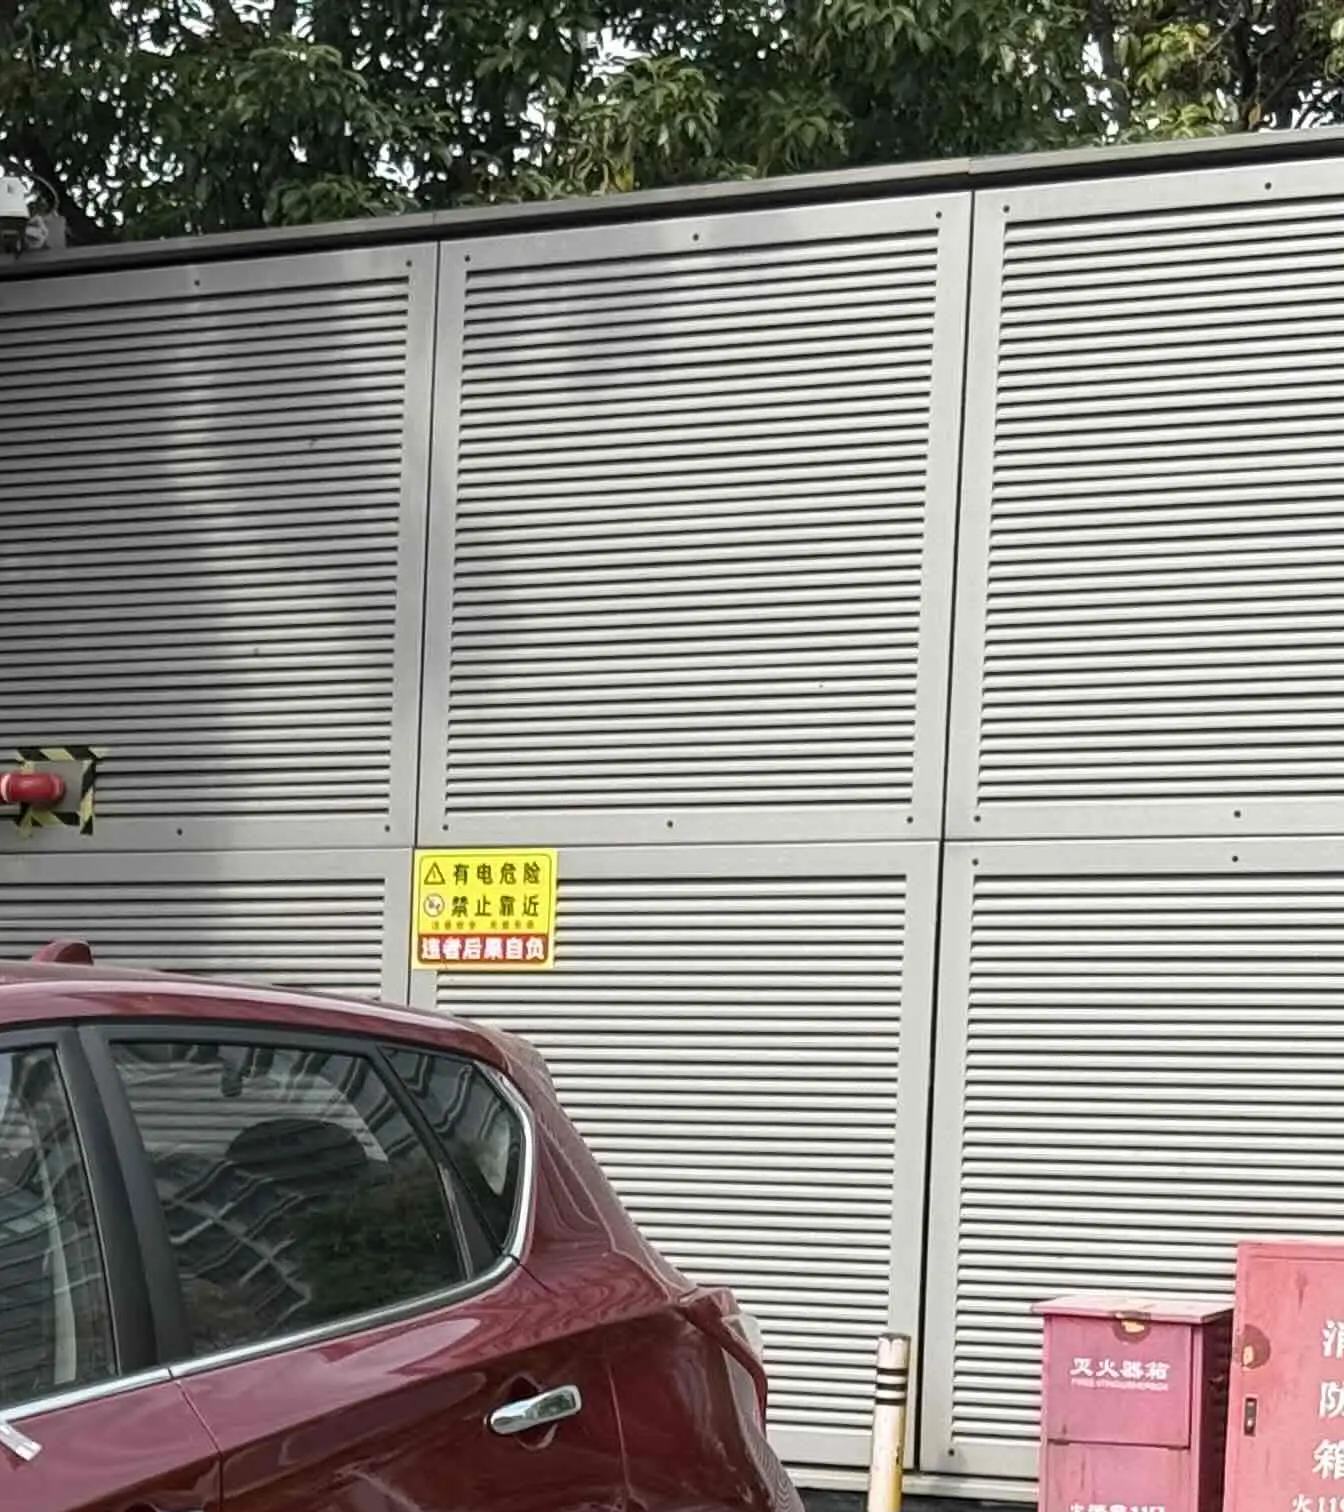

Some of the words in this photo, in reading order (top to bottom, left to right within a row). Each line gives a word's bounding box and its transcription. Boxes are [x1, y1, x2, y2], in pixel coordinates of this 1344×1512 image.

[453, 862, 541, 885] 有电危险
[451, 894, 540, 917] 禁止靠近
[1070, 1358, 1170, 1380] 灭火器箱
